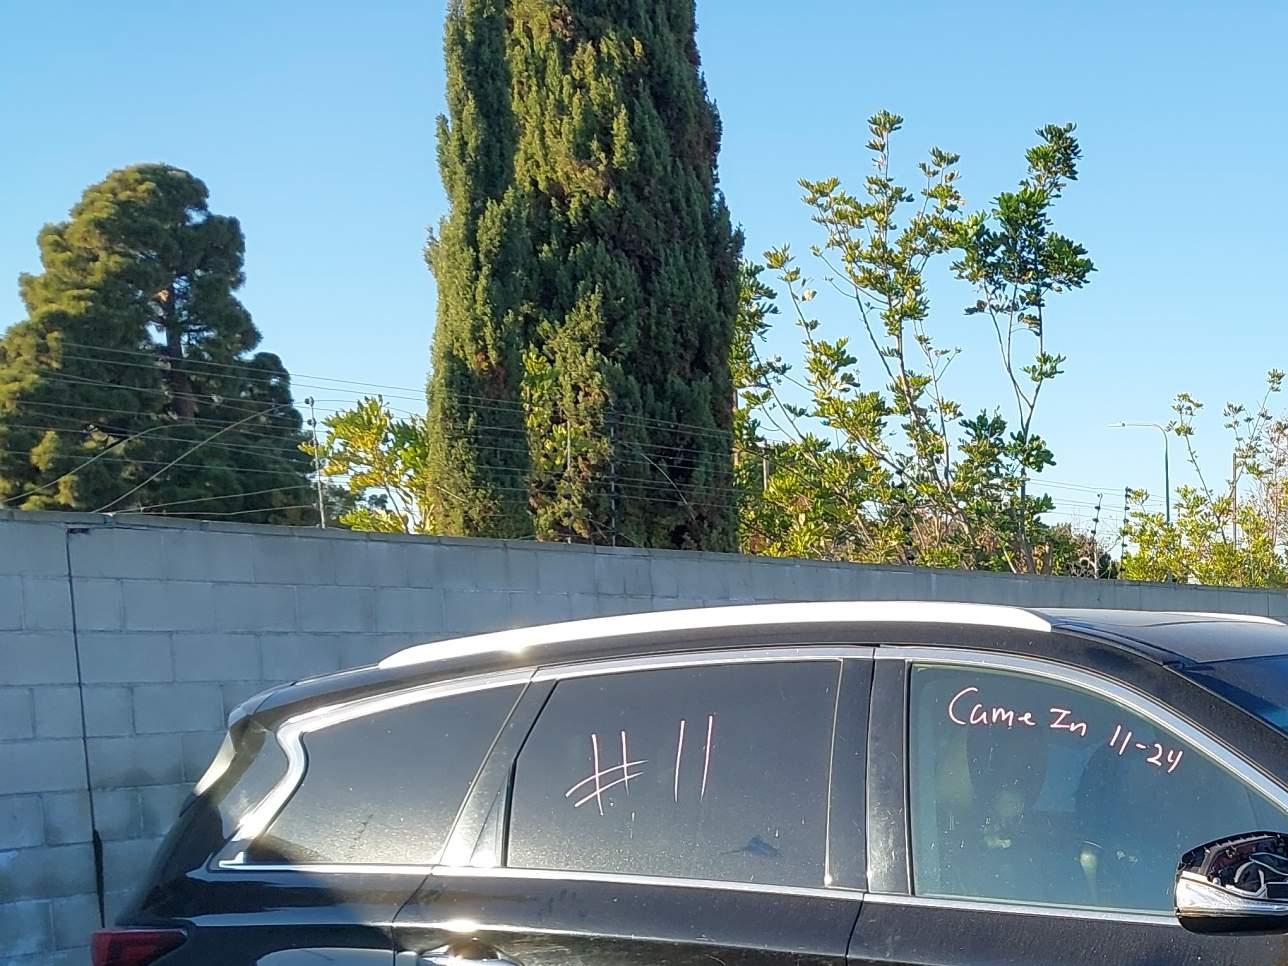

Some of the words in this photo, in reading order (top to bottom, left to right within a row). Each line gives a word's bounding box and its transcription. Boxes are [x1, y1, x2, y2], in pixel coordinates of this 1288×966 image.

[564, 730, 650, 817] #
[948, 687, 1036, 726] Came
[1109, 724, 1184, 774] 11-24
